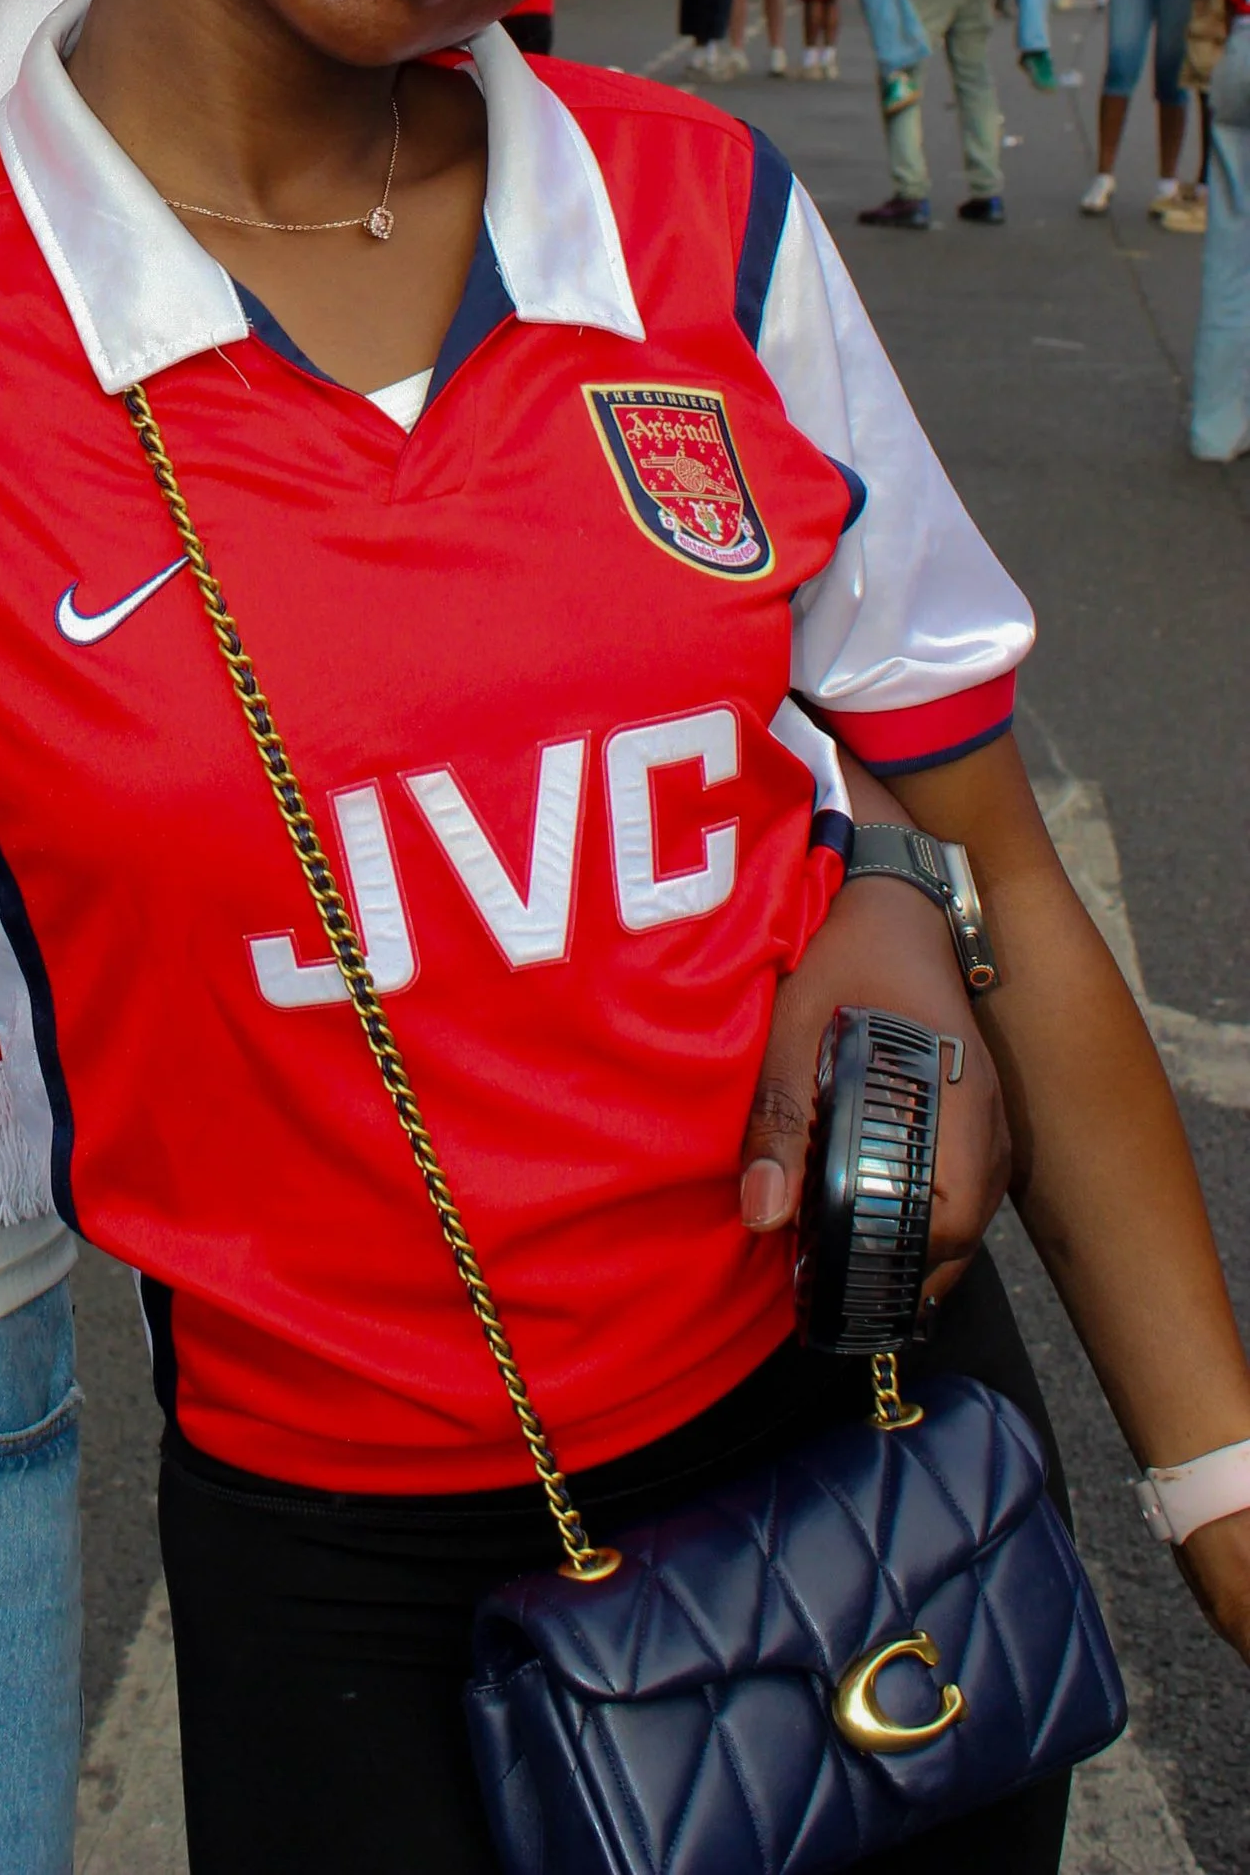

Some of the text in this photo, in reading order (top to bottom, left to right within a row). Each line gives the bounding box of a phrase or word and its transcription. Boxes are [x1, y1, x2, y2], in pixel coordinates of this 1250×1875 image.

[600, 391, 718, 410] THE GUNNERS
[625, 411, 722, 445] Arsenal
[245, 702, 740, 1011] JVC
